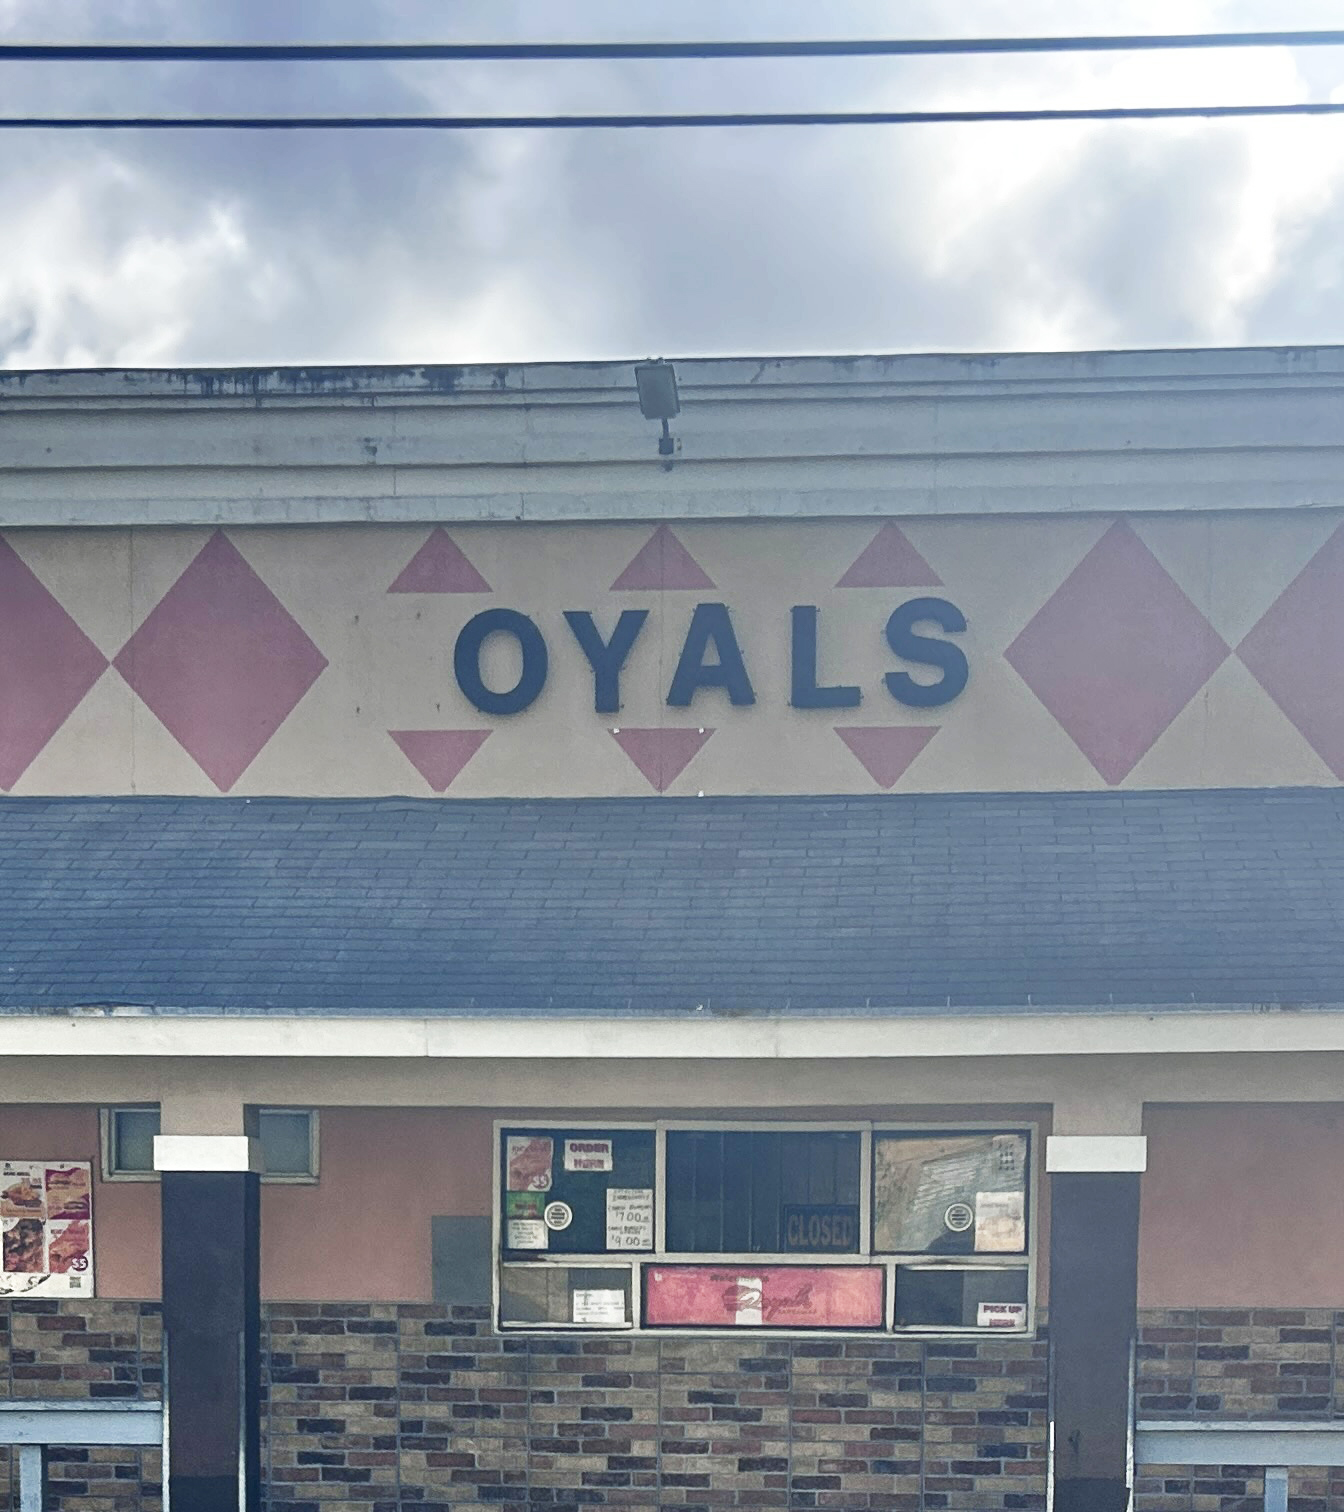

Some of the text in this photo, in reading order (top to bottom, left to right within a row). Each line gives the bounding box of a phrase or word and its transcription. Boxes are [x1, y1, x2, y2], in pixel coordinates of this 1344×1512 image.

[454, 597, 969, 715] OYALS
[569, 1143, 609, 1153] ORDER
[787, 1214, 855, 1249] CLOSED
[983, 1304, 1023, 1314] PICK UP
